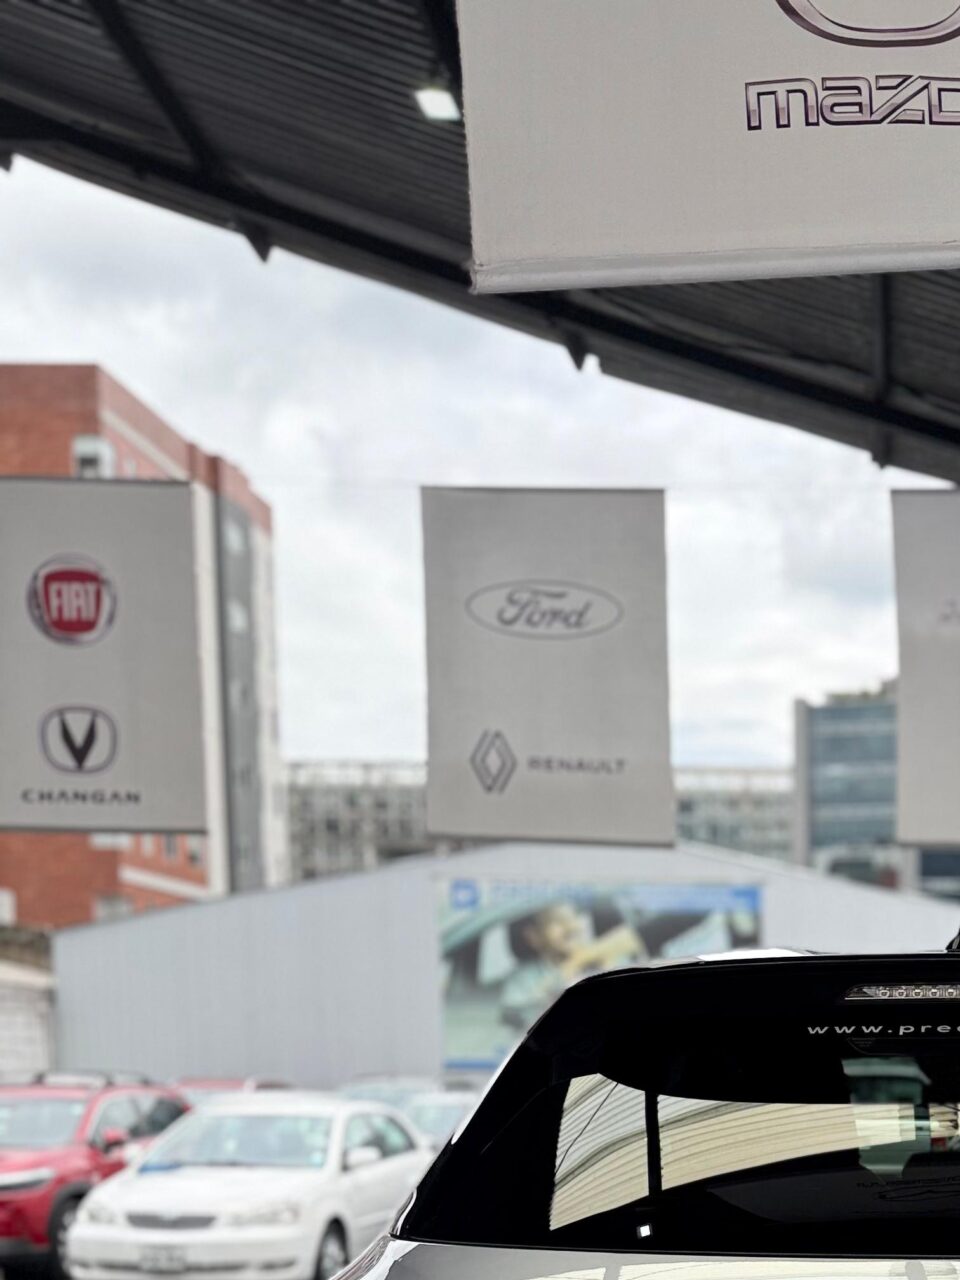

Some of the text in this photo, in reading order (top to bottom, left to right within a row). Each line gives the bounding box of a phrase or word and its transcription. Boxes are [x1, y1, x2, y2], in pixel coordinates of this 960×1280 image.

[50, 580, 99, 623] FIAT
[496, 587, 592, 630] Ford
[526, 756, 627, 775] RENAULT
[21, 789, 142, 804] CHANGAN
